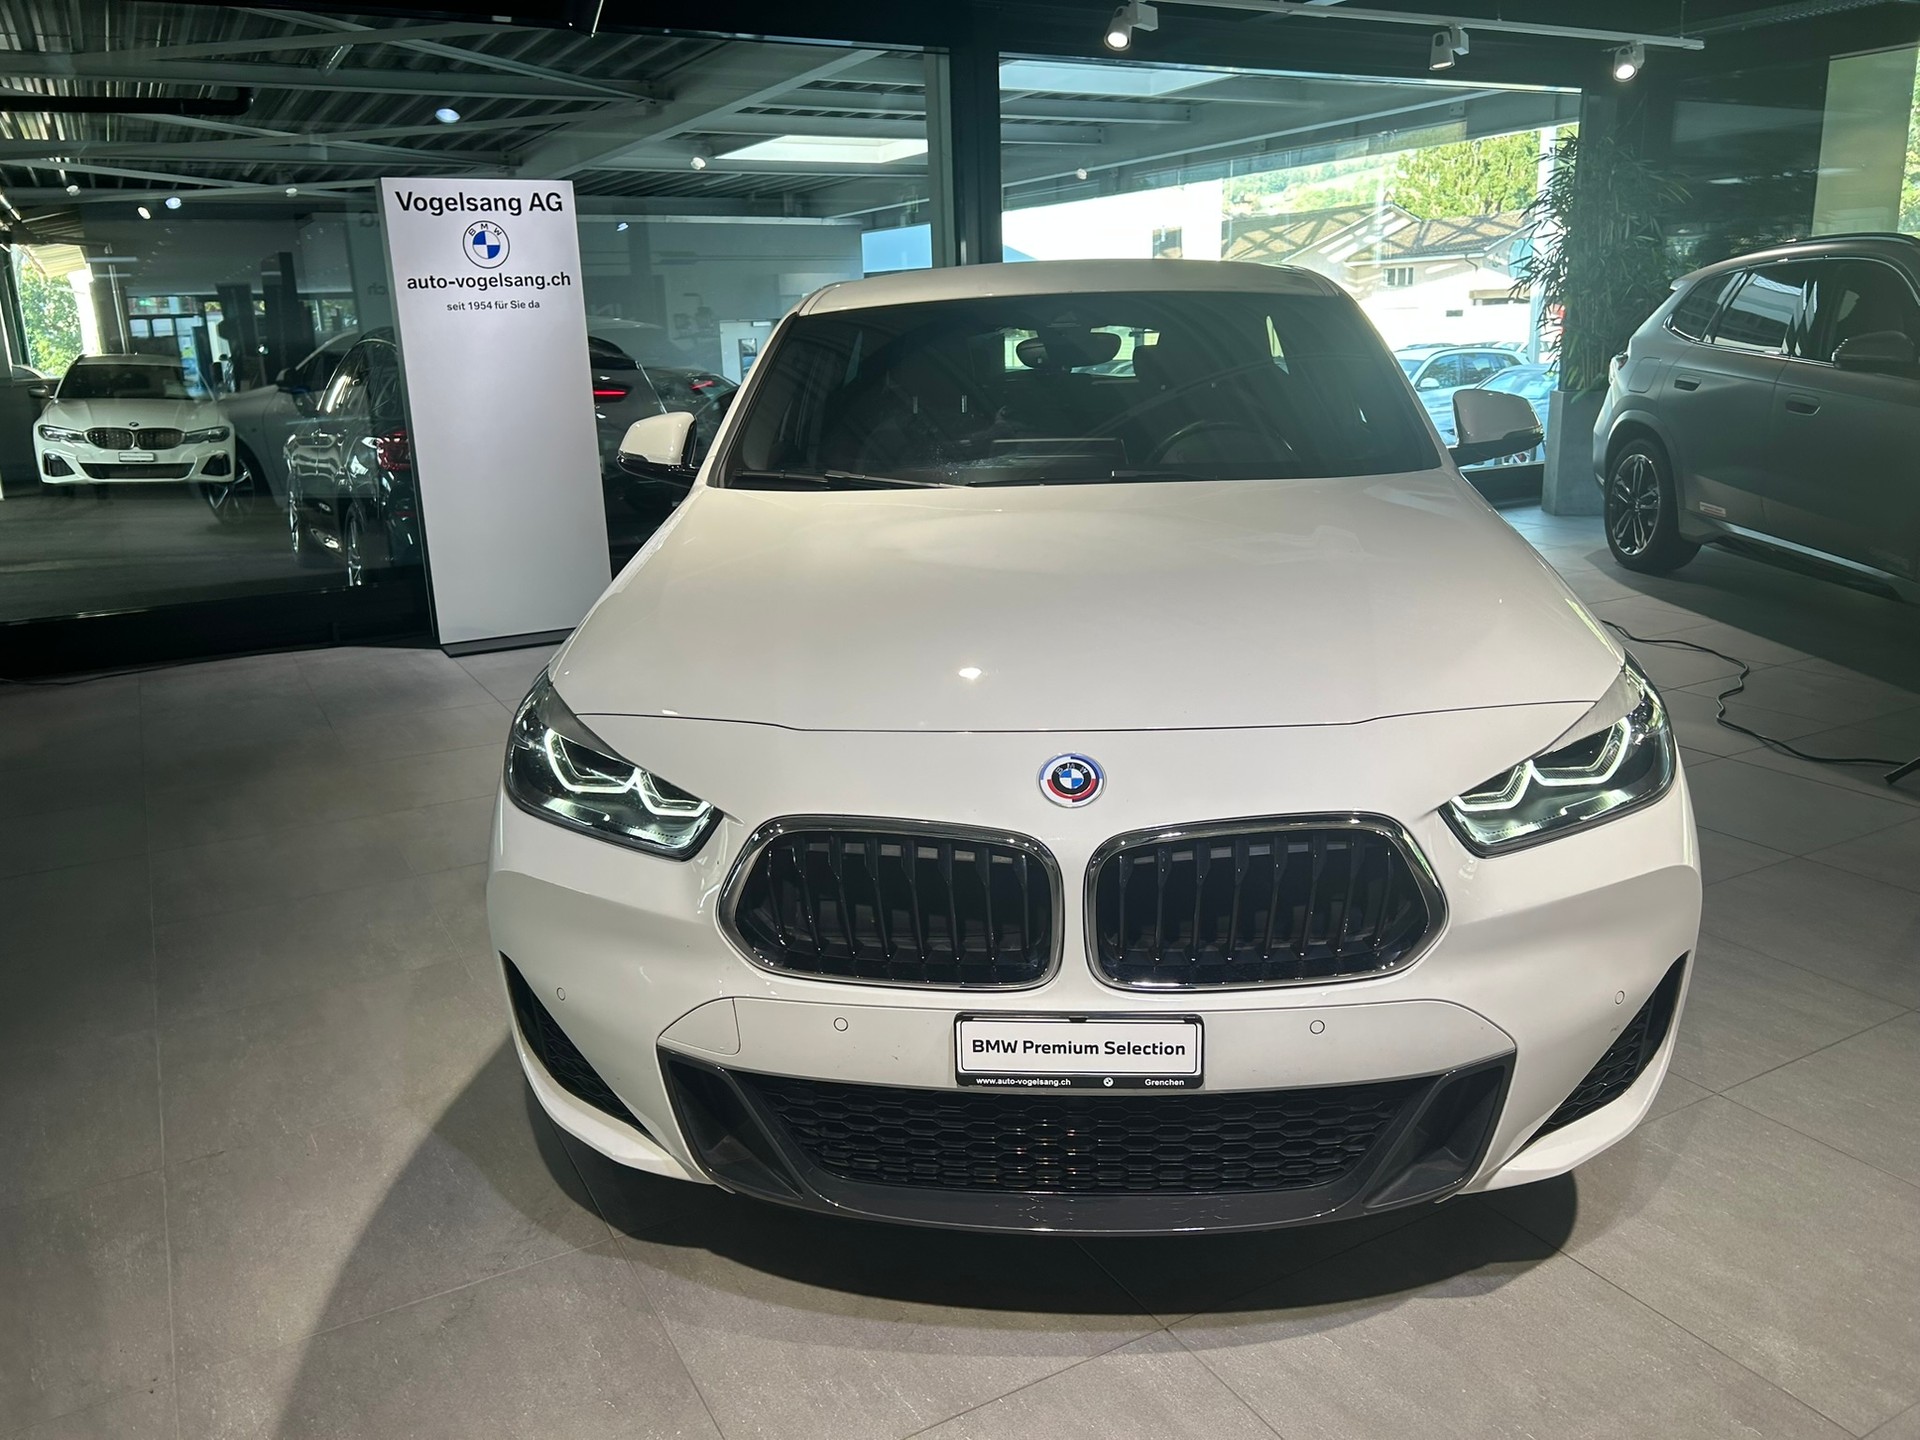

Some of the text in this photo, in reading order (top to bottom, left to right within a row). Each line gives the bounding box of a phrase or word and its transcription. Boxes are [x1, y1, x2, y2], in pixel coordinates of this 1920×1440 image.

[394, 191, 563, 216] Vogelsang AG
[468, 223, 502, 236] BMW
[407, 272, 571, 291] auto-vogelsang.ch
[446, 300, 540, 311] seit 1954 für Sie da
[972, 1039, 1185, 1056] BMW Premium Selection
[976, 1077, 1185, 1088] www.auto-vogelsang.ch Grenchen
